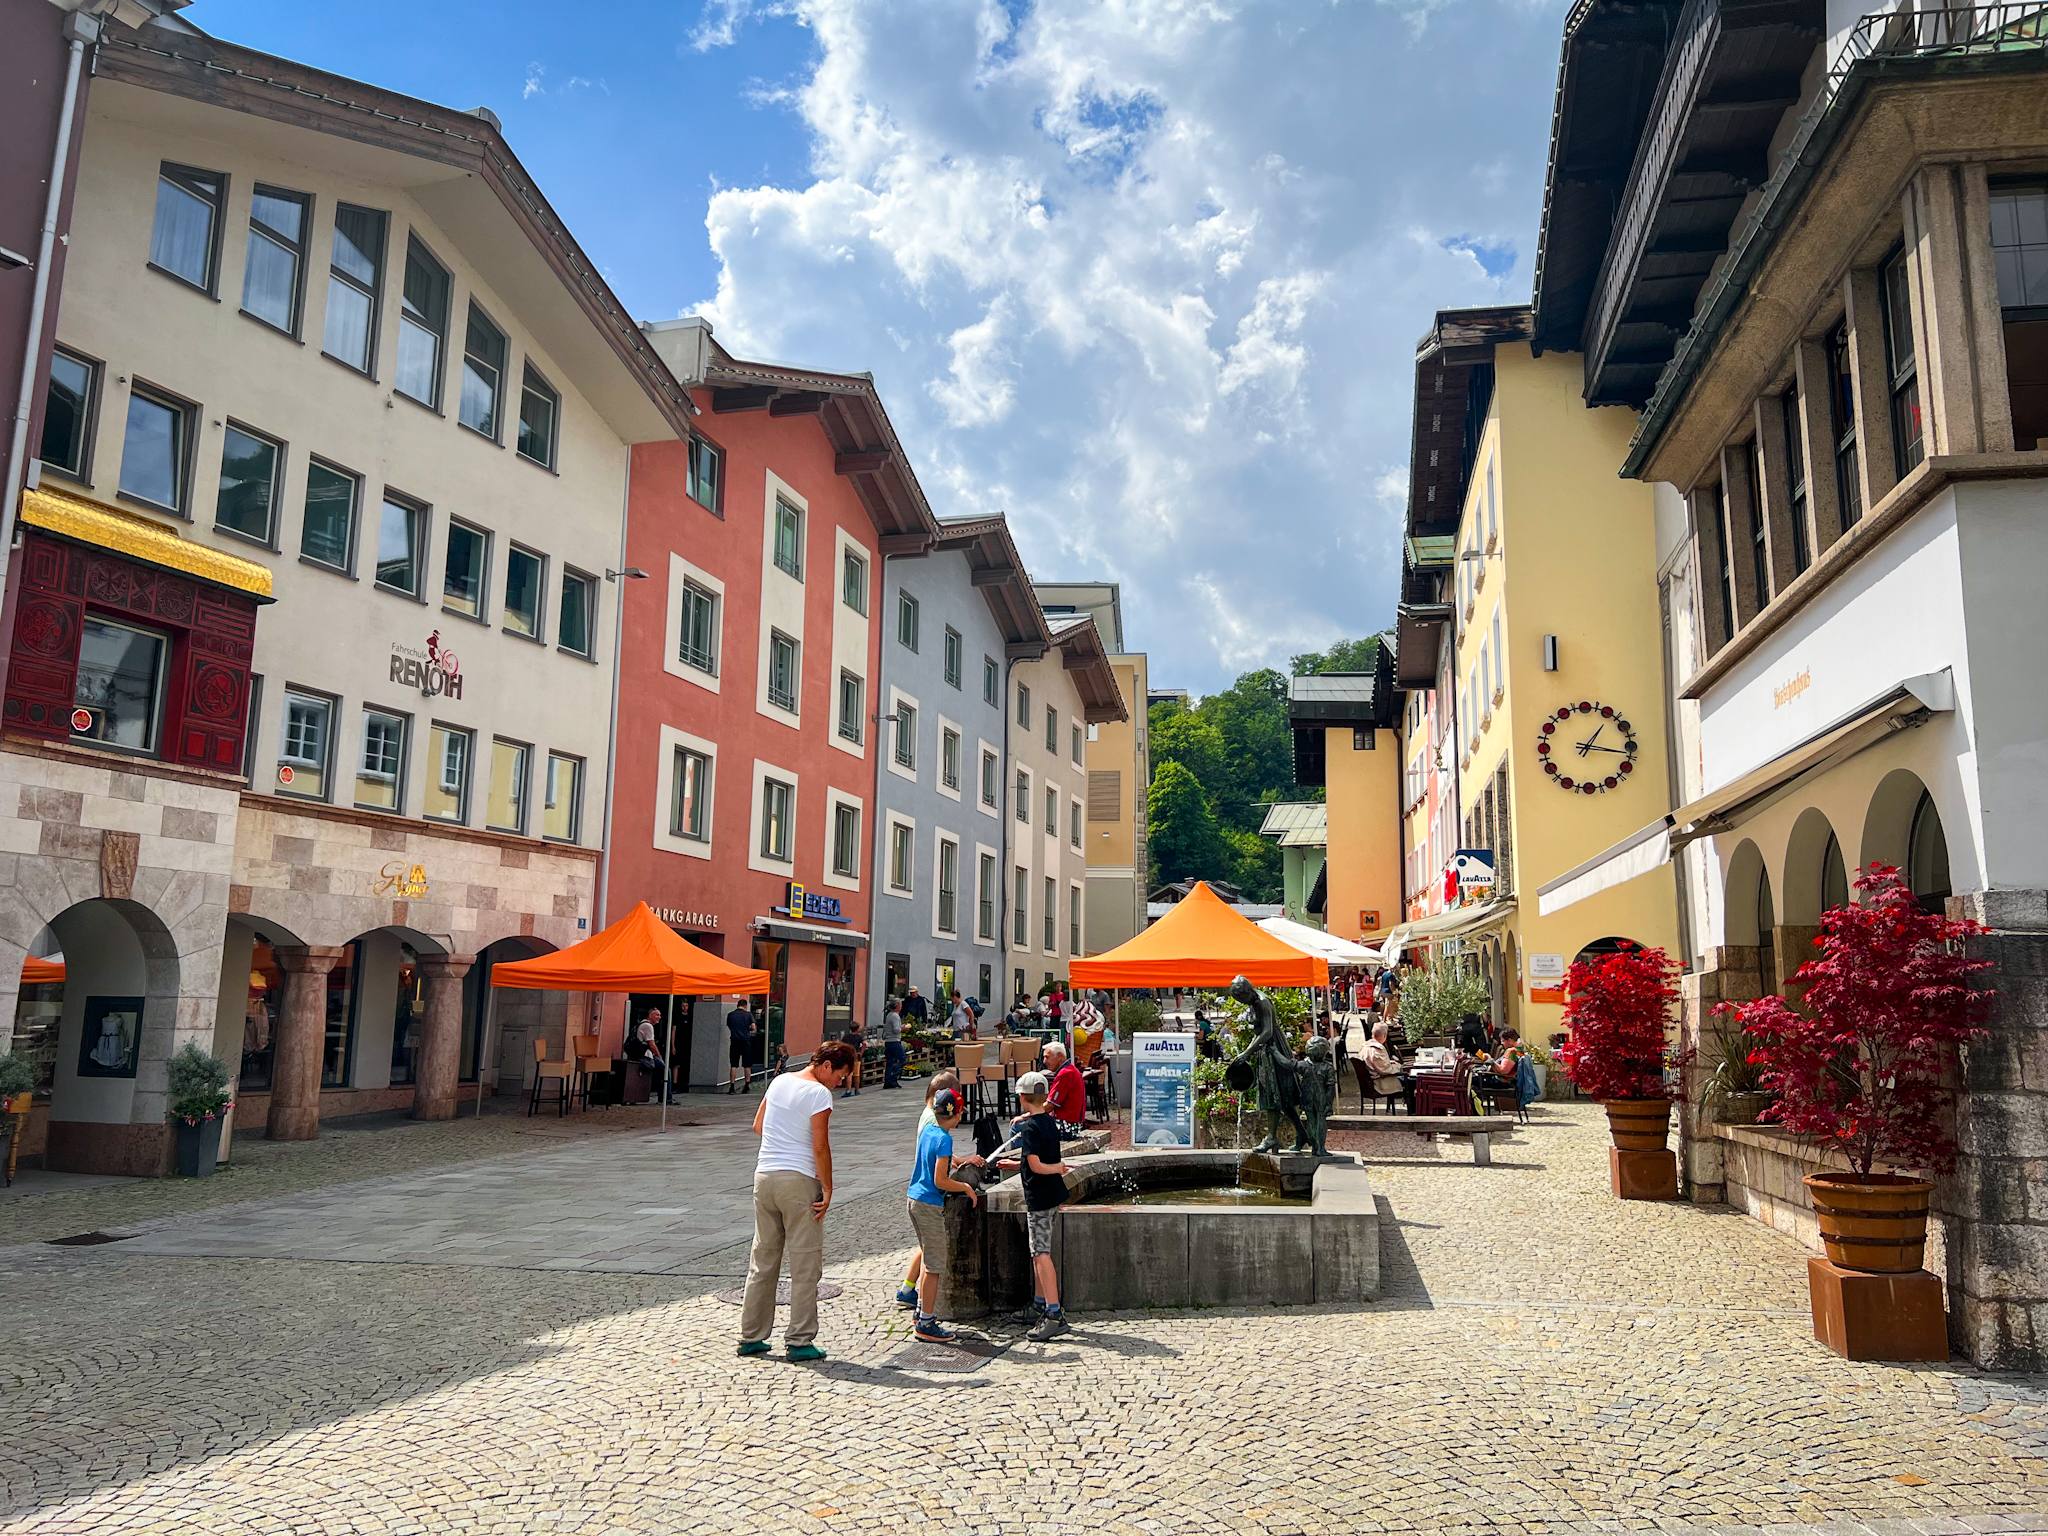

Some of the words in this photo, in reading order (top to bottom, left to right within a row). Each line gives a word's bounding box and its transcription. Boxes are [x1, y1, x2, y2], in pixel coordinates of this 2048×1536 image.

[391, 642, 428, 659] Fahrschule
[389, 654, 463, 701] RENOTH
[804, 893, 841, 916] EDEKA
[1365, 916, 1374, 924] M
[1144, 1040, 1185, 1052] LAVAZZA
[1145, 1066, 1182, 1077] LAVAZZA
